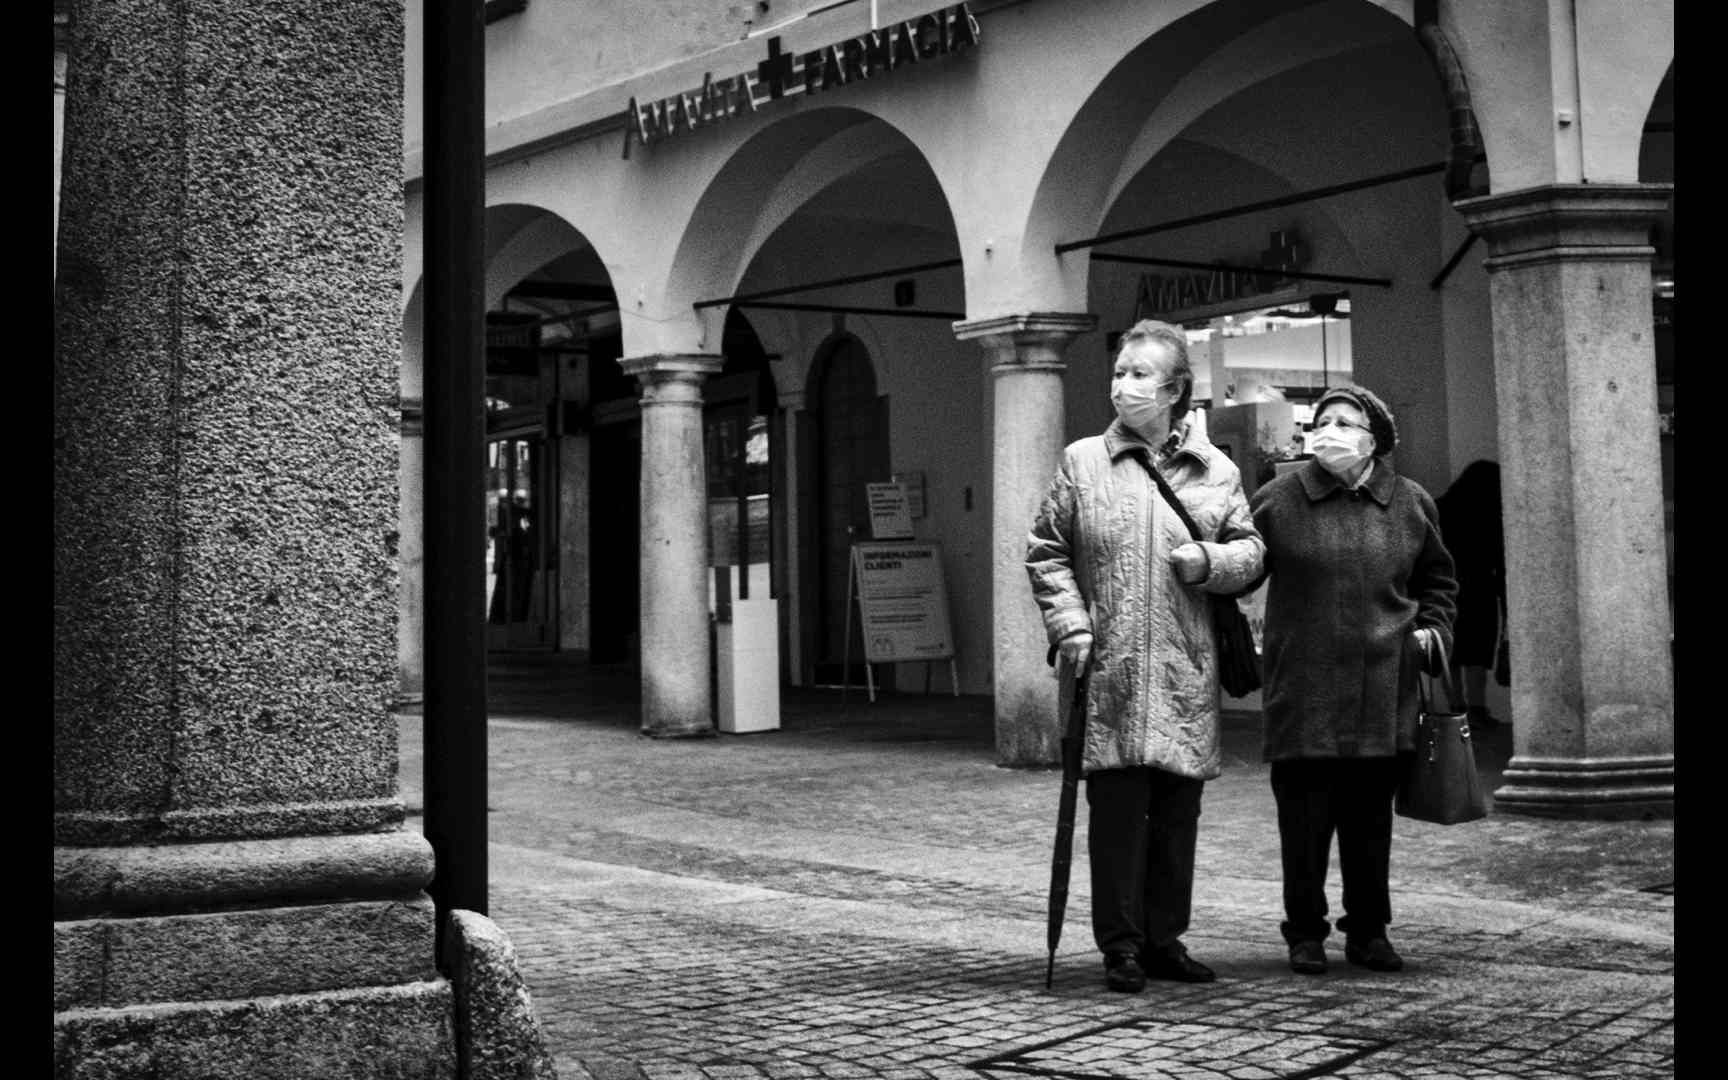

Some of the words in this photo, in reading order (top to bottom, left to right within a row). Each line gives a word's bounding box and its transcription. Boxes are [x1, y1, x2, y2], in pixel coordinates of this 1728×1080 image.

[804, 3, 974, 95] FARMACIA
[863, 550, 932, 560] INFORMAZIONI
[864, 560, 903, 571] CLIENTI
